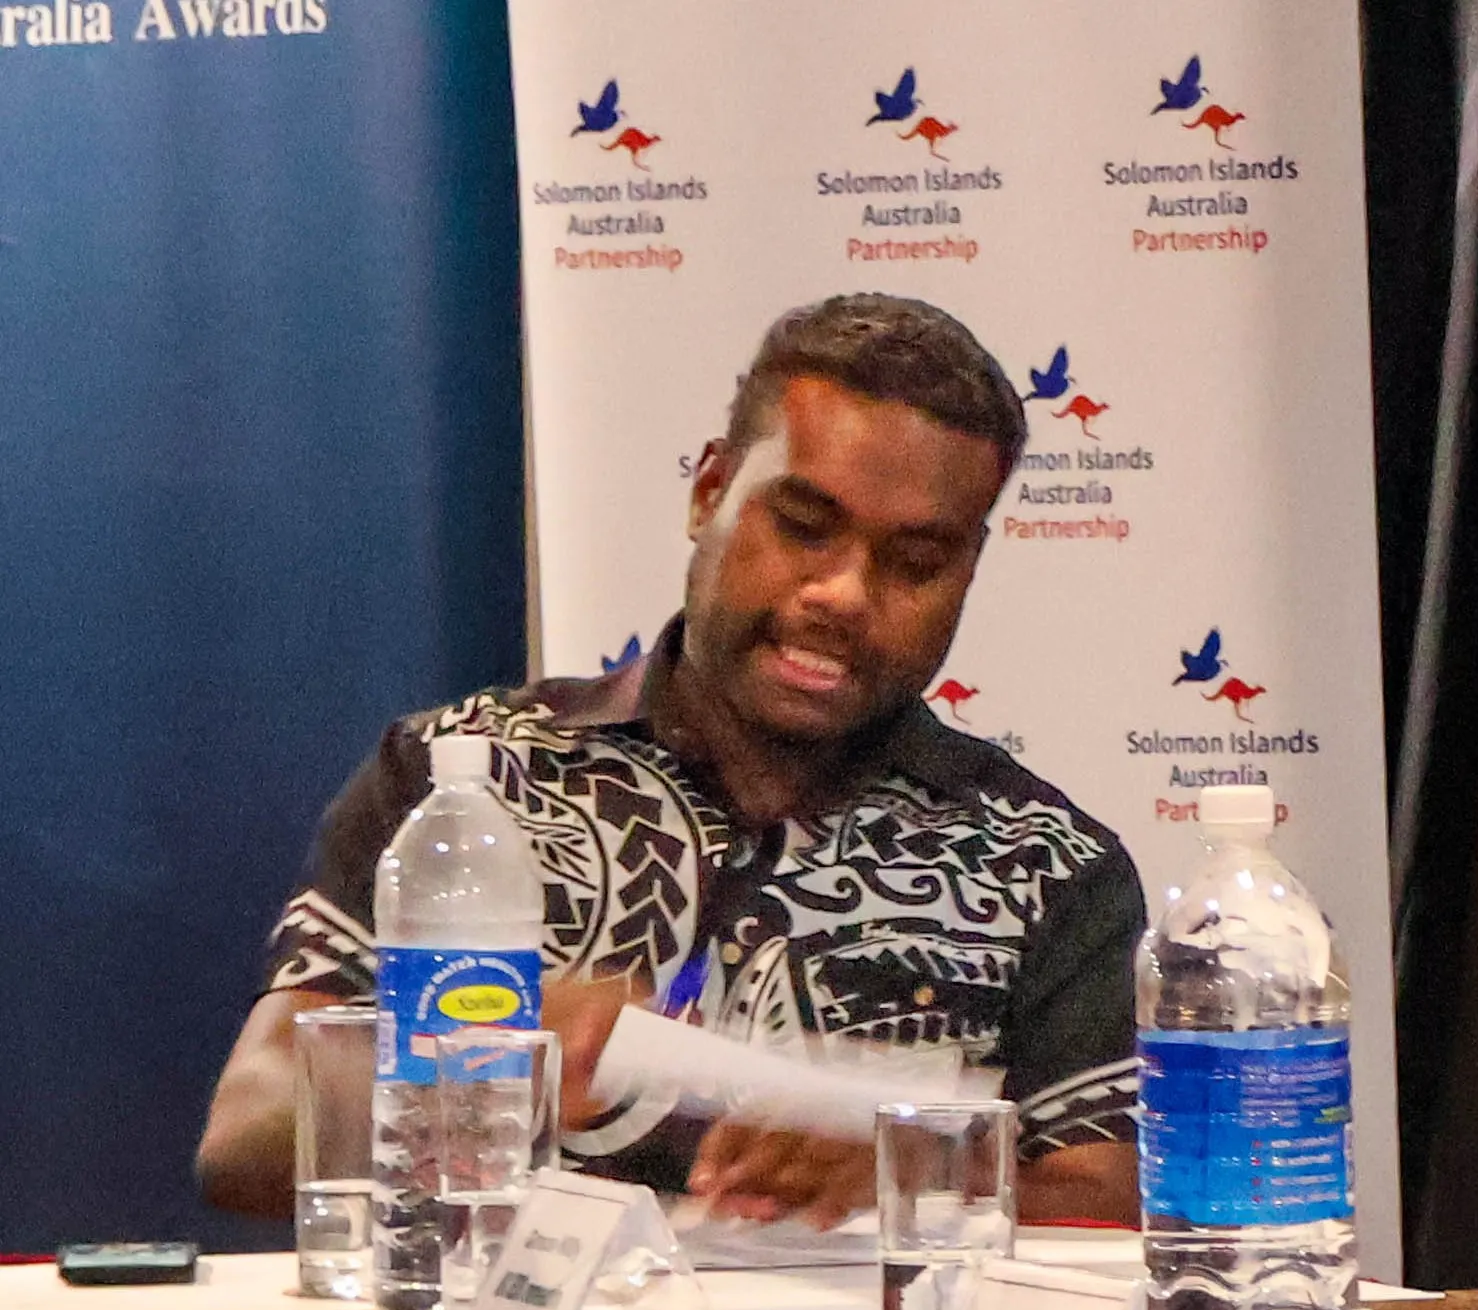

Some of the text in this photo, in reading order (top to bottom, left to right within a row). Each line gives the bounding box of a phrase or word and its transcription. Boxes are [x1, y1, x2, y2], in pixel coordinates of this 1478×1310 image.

[135, 0, 329, 41] Awards
[817, 165, 1002, 196] Solomon Islands
[1104, 155, 1299, 186] Solomon Islands
[533, 176, 707, 205] Solomon Islands
[1146, 190, 1248, 217] Australia
[567, 212, 664, 235] Australia
[862, 199, 961, 226] Australia
[846, 235, 979, 264] Partnership
[1132, 224, 1268, 254] Partnership
[554, 244, 683, 274] Partnership
[1077, 445, 1154, 470] Islands
[1019, 480, 1113, 504] Australia
[1004, 515, 1129, 543] Partnership
[1127, 728, 1320, 754] Solomon Islands
[1168, 763, 1268, 787] Australia
